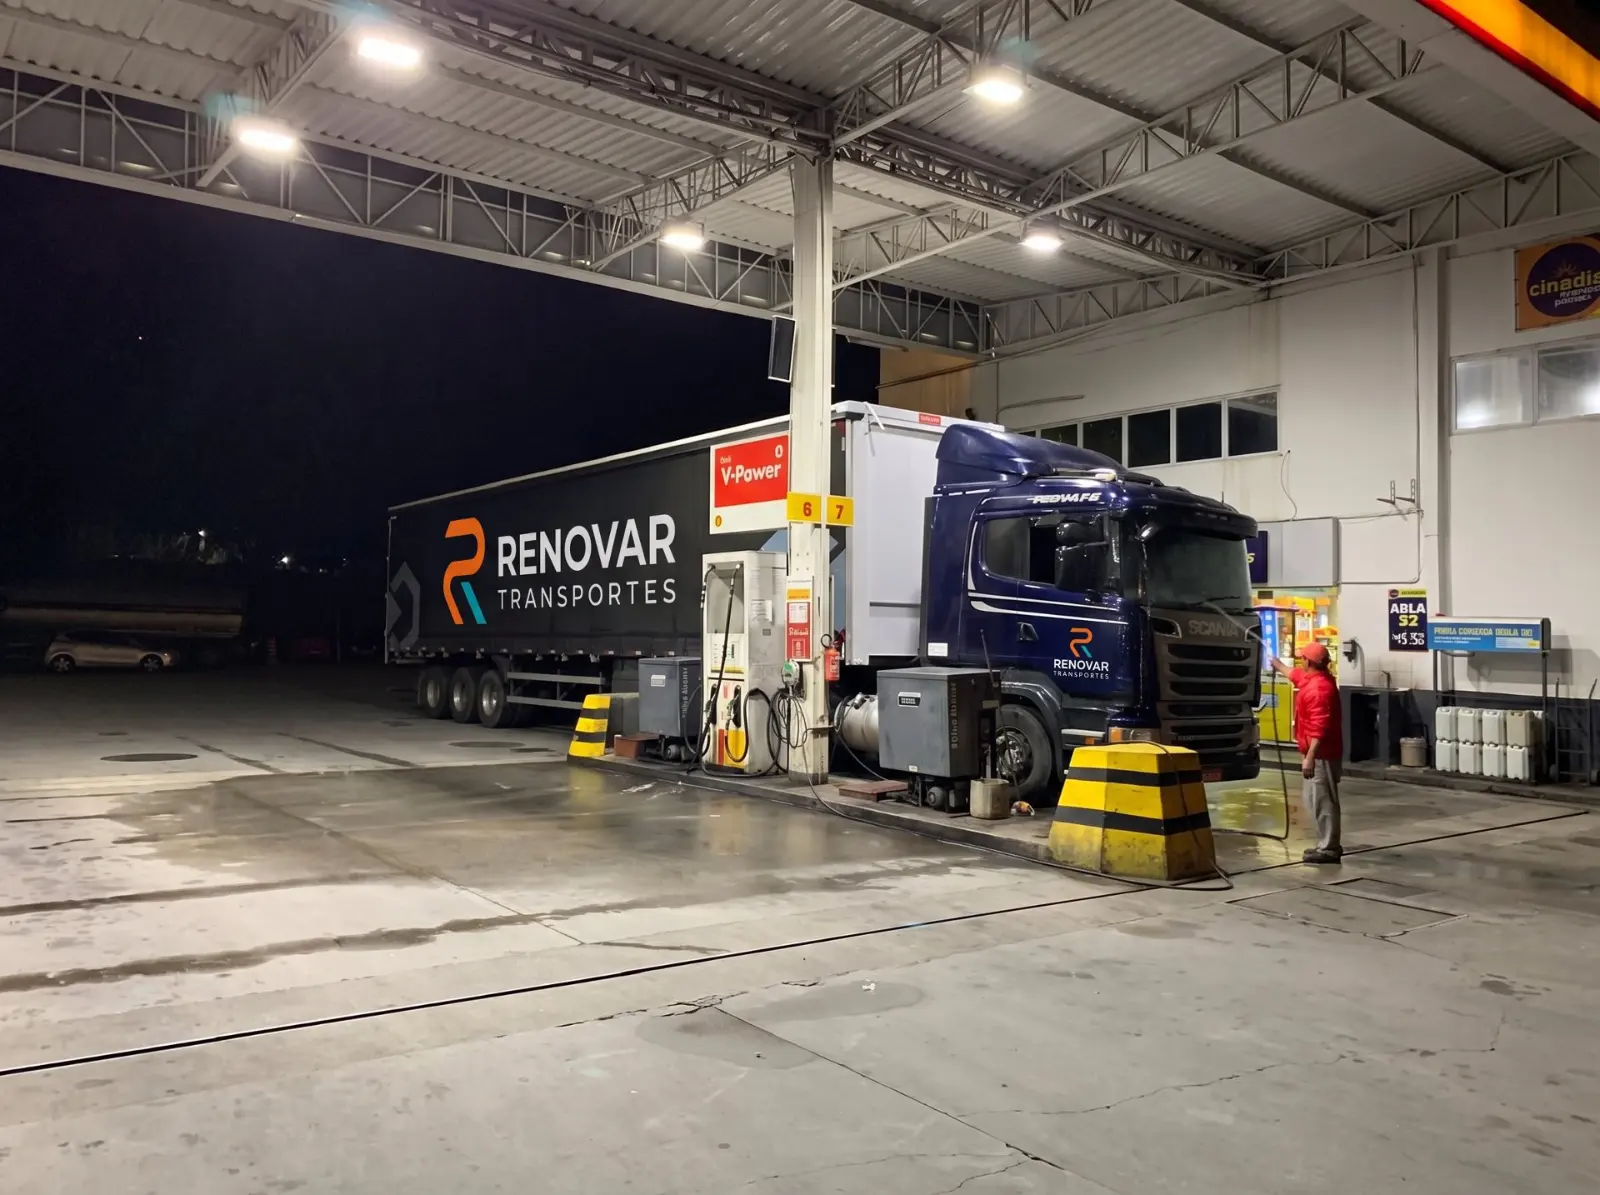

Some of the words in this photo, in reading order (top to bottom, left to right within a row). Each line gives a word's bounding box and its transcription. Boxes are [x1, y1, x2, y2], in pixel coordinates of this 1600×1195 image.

[721, 463, 782, 486] V-Power
[803, 502, 812, 517] 6
[836, 505, 844, 519] 7
[498, 514, 676, 577] RENOVAR
[498, 578, 676, 610] TRANSPORTES
[1390, 603, 1426, 614] ABLA
[1188, 620, 1238, 637] SCANIA
[1053, 659, 1110, 671] RENOVAR
[1053, 670, 1110, 680] TRANSPORTES
